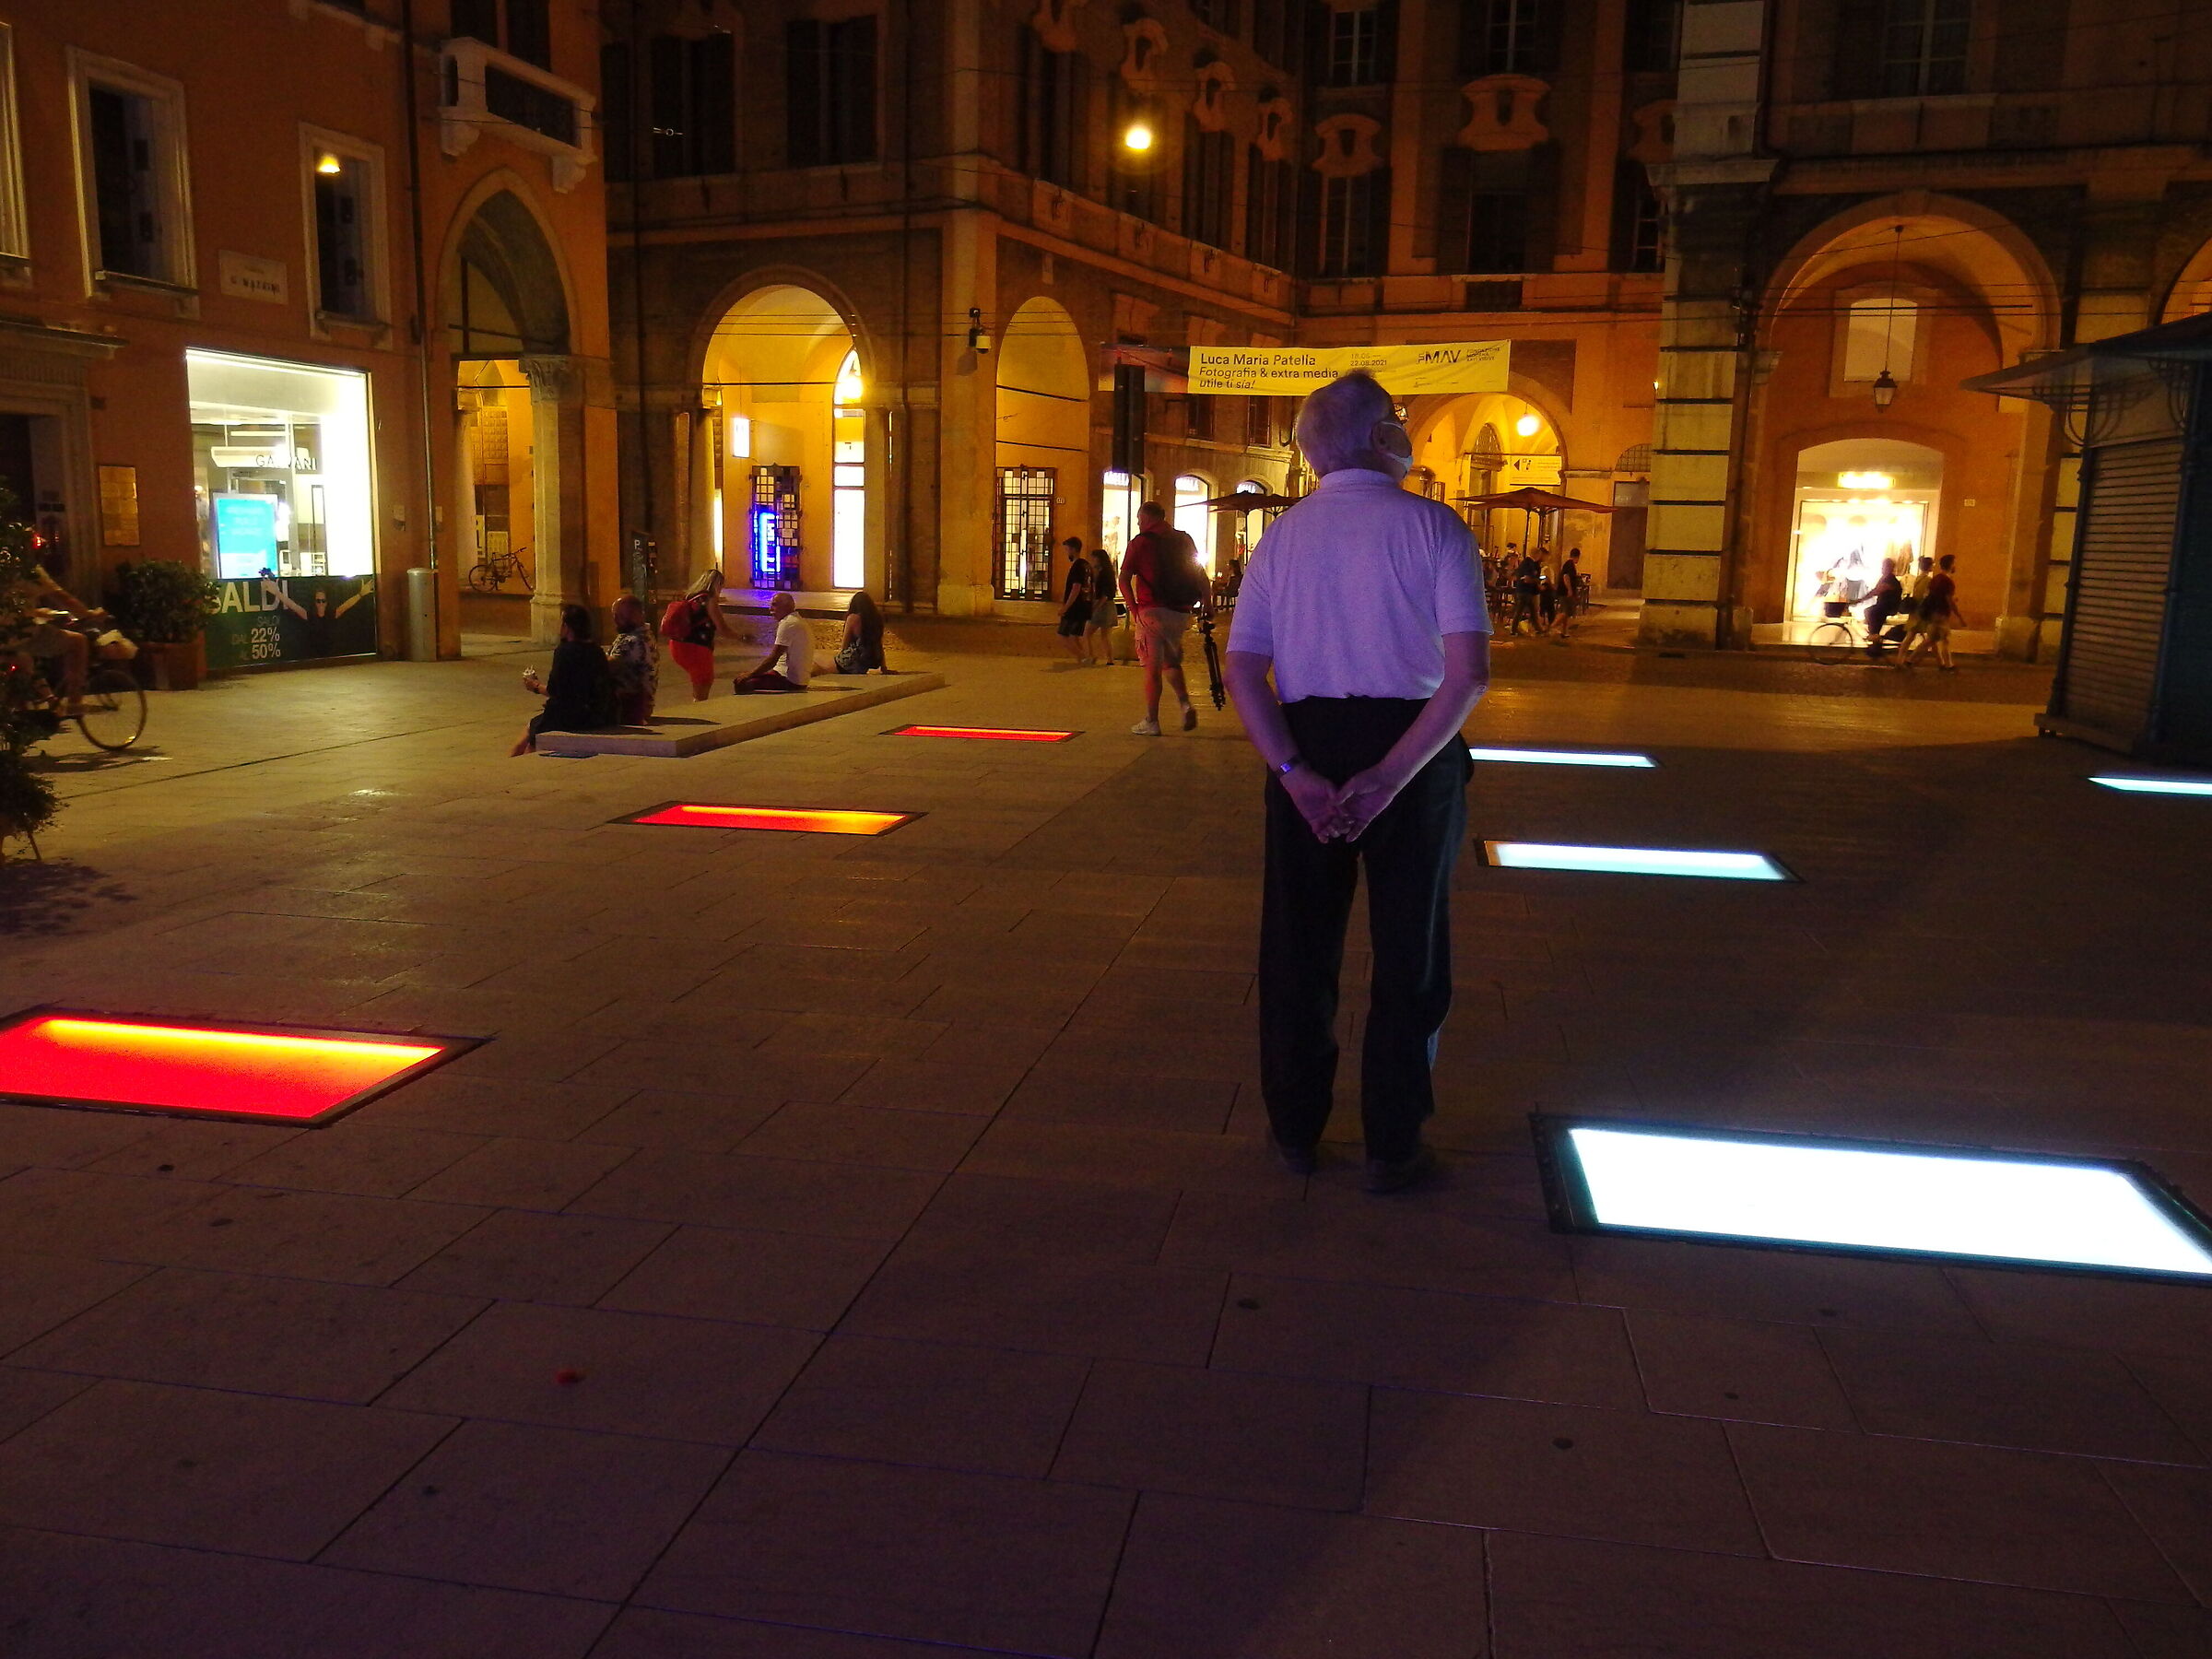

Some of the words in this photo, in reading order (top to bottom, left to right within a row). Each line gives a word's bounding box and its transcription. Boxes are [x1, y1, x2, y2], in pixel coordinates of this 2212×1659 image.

[1201, 353, 1230, 365] Luca
[1233, 353, 1269, 366] Maria
[1273, 354, 1316, 366] Patella
[1199, 367, 1257, 379] Fotografia
[1260, 368, 1268, 378] &
[1271, 369, 1299, 378] extra
[1303, 369, 1338, 379] media
[1199, 379, 1224, 388] utile
[1226, 380, 1233, 388] ti
[1235, 380, 1255, 389] sia!
[256, 454, 317, 471] GAVANI
[251, 627, 280, 643] 22%
[252, 642, 281, 660] 50%
